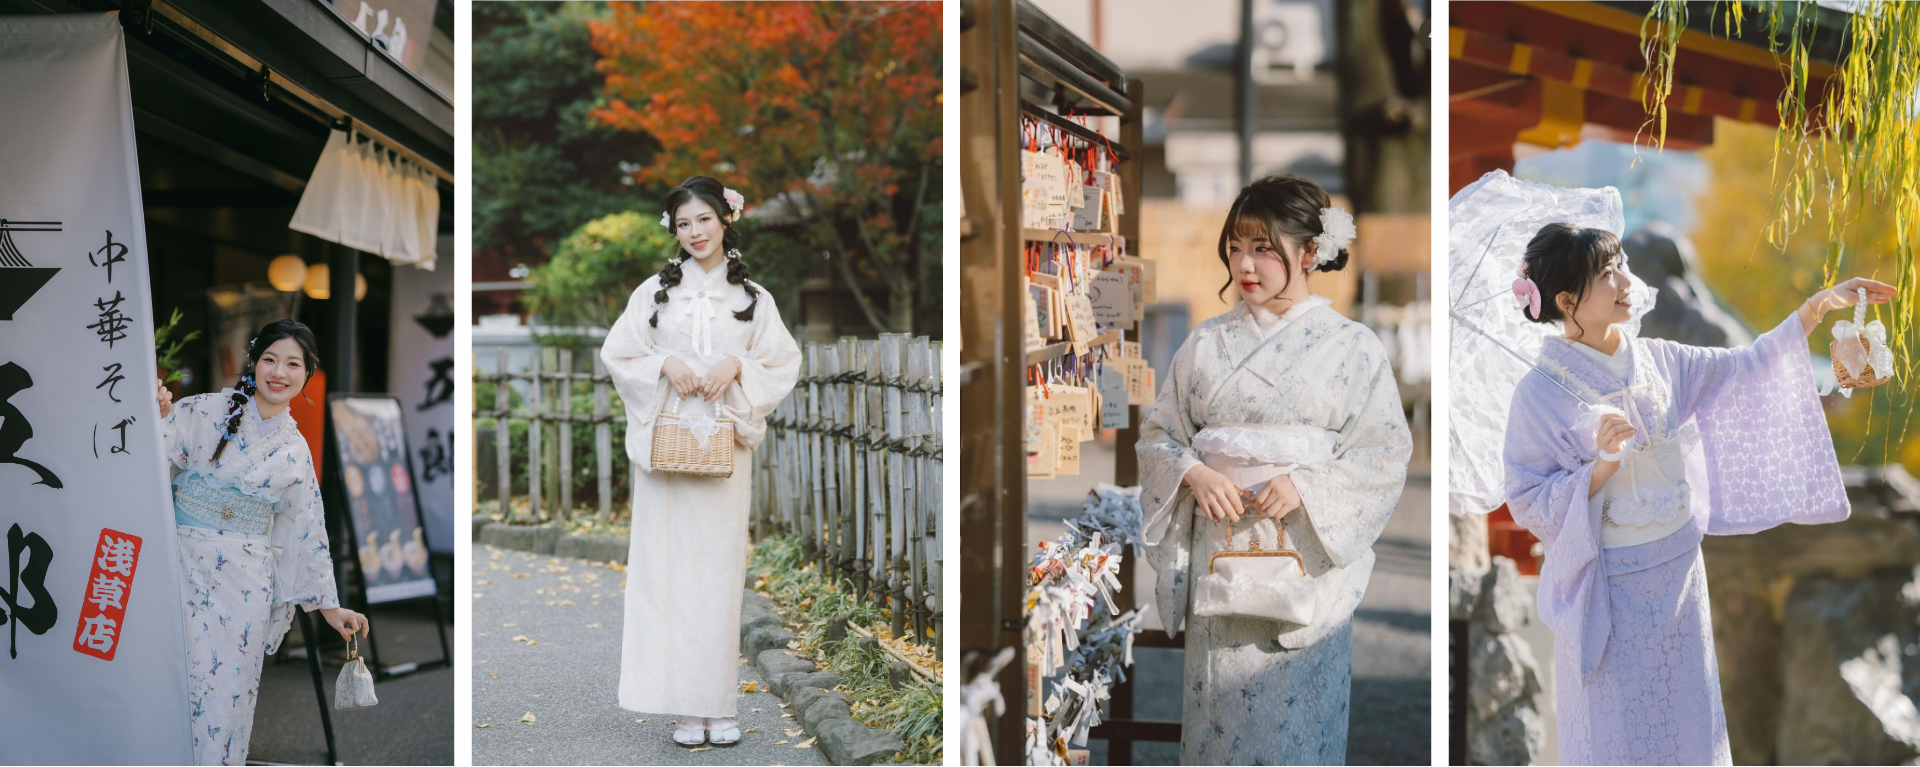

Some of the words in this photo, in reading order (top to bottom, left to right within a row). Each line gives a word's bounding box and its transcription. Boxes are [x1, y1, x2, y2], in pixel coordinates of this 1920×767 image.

[86, 229, 136, 459] 中華そば
[78, 534, 136, 654] 浅草店
